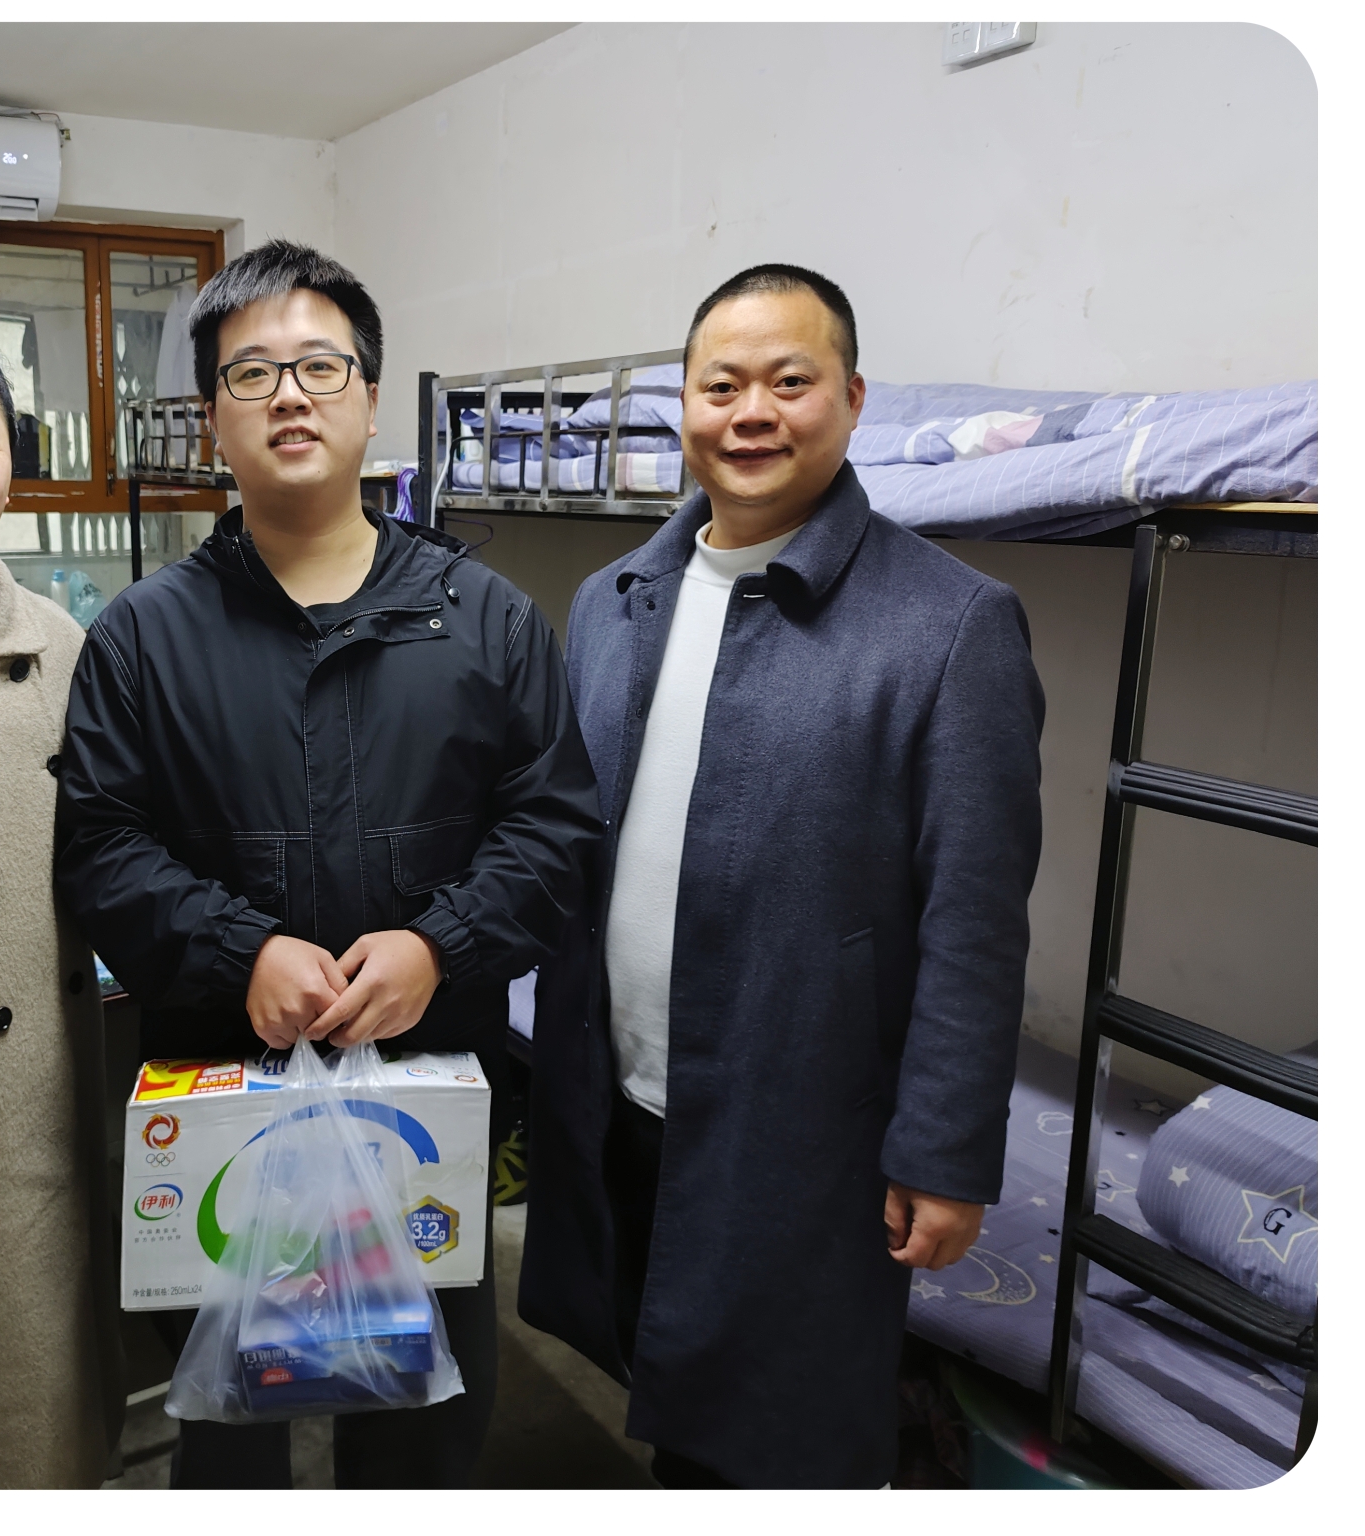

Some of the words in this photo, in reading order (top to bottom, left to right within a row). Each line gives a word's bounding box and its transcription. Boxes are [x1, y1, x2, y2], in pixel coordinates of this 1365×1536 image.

[141, 1193, 176, 1210] 伊利
[411, 1221, 446, 1241] 3.2g
[1263, 1208, 1292, 1235] G
